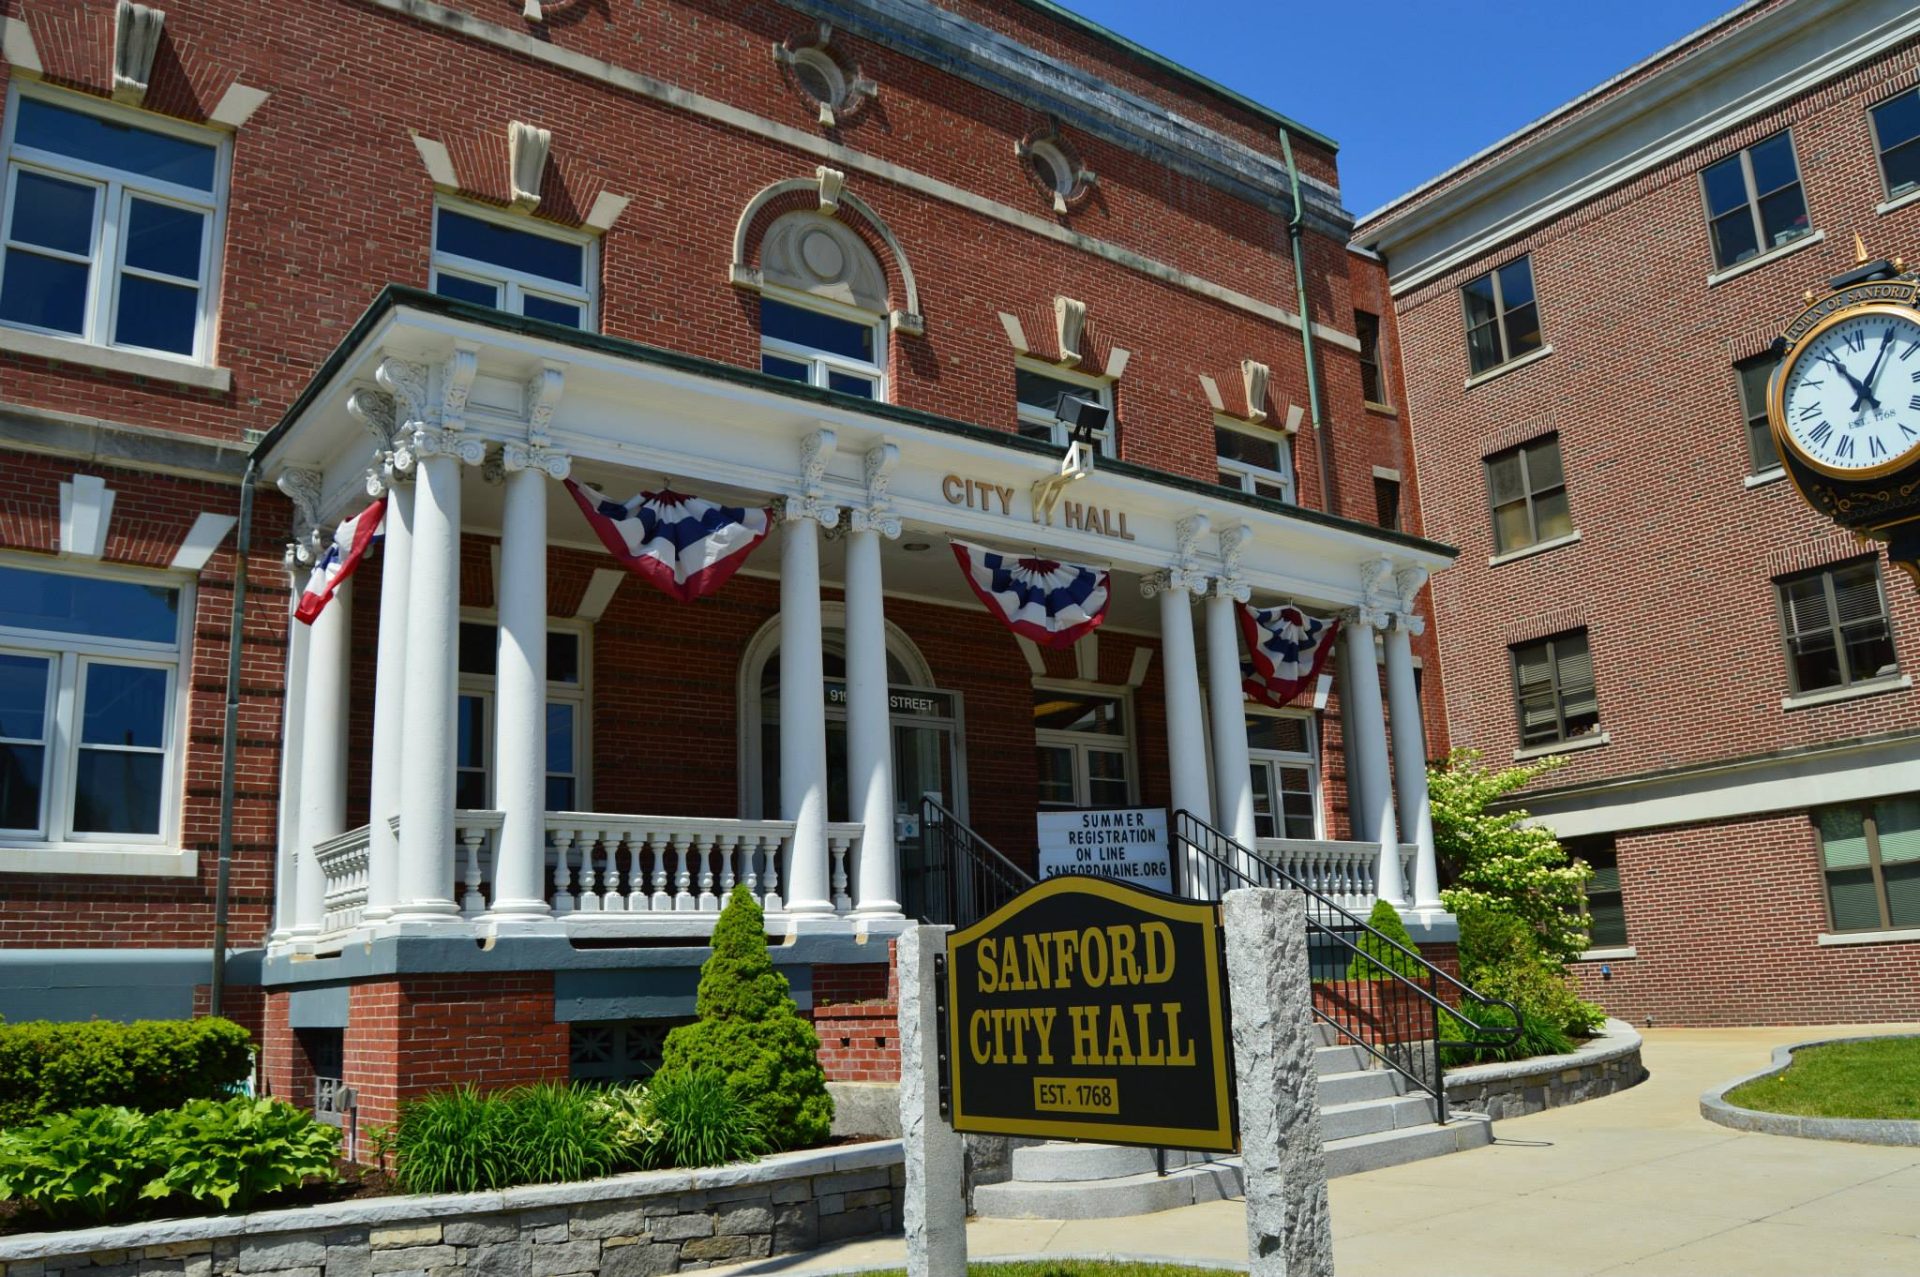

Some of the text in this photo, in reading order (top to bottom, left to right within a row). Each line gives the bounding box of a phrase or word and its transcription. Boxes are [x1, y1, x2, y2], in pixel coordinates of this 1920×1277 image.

[1789, 286, 1911, 338] TOWN OF SANFORD
[1842, 328, 1866, 357] XII
[1800, 376, 1824, 391] X
[1798, 401, 1823, 422] IX
[1874, 408, 1897, 422] 1768
[1808, 420, 1834, 449] VIII
[1897, 422, 1918, 441] V
[1835, 434, 1855, 459] VII
[1869, 435, 1887, 458] VI
[943, 474, 1135, 541] CITY HALL
[890, 695, 934, 711] STREET
[1082, 812, 1145, 828] SUMMER
[1069, 828, 1156, 845] REGISTRATION
[1076, 846, 1125, 861] ON LINE
[976, 921, 1176, 993] SANFORD
[969, 1002, 1196, 1067] CITY HALL
[1040, 1084, 1112, 1107] EST. 1768
